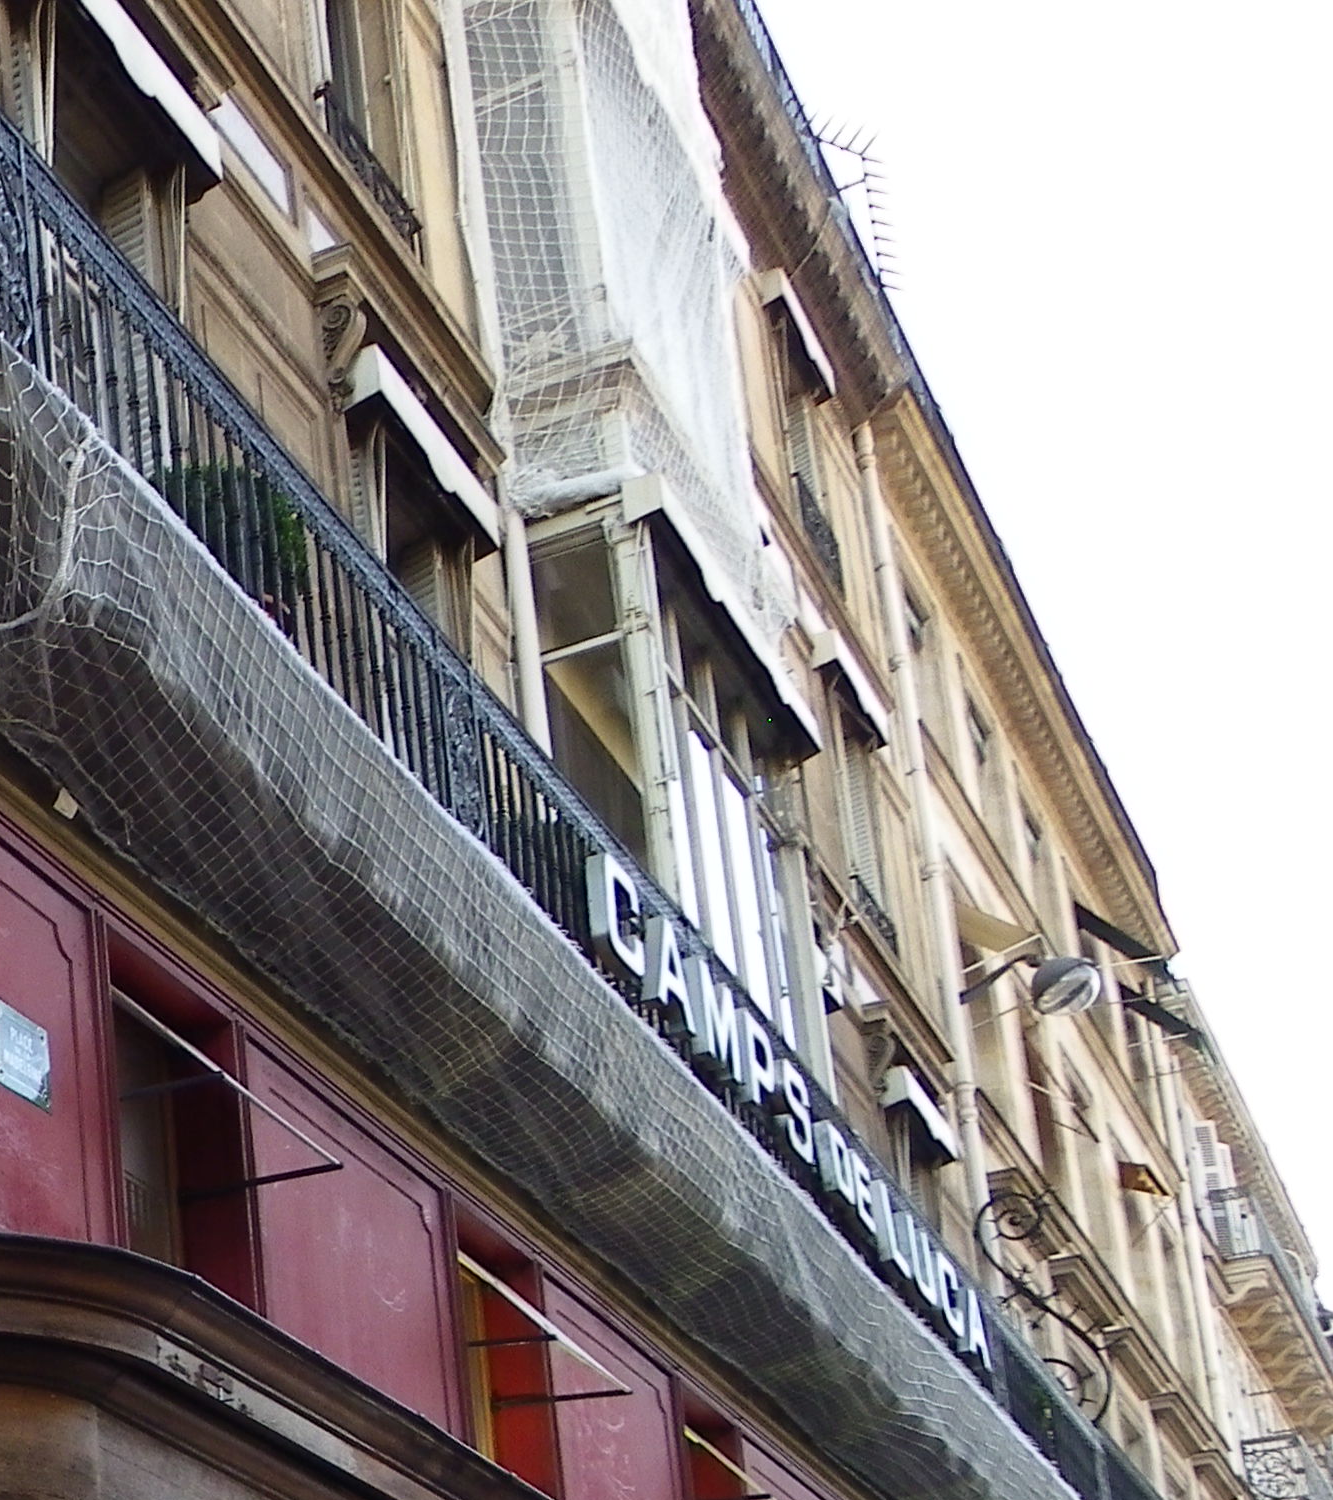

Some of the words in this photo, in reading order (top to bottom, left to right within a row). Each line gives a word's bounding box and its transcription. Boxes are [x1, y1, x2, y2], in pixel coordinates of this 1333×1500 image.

[587, 852, 817, 1166] CAMPS
[815, 1119, 879, 1238] DE
[873, 1179, 993, 1372] LUCA
